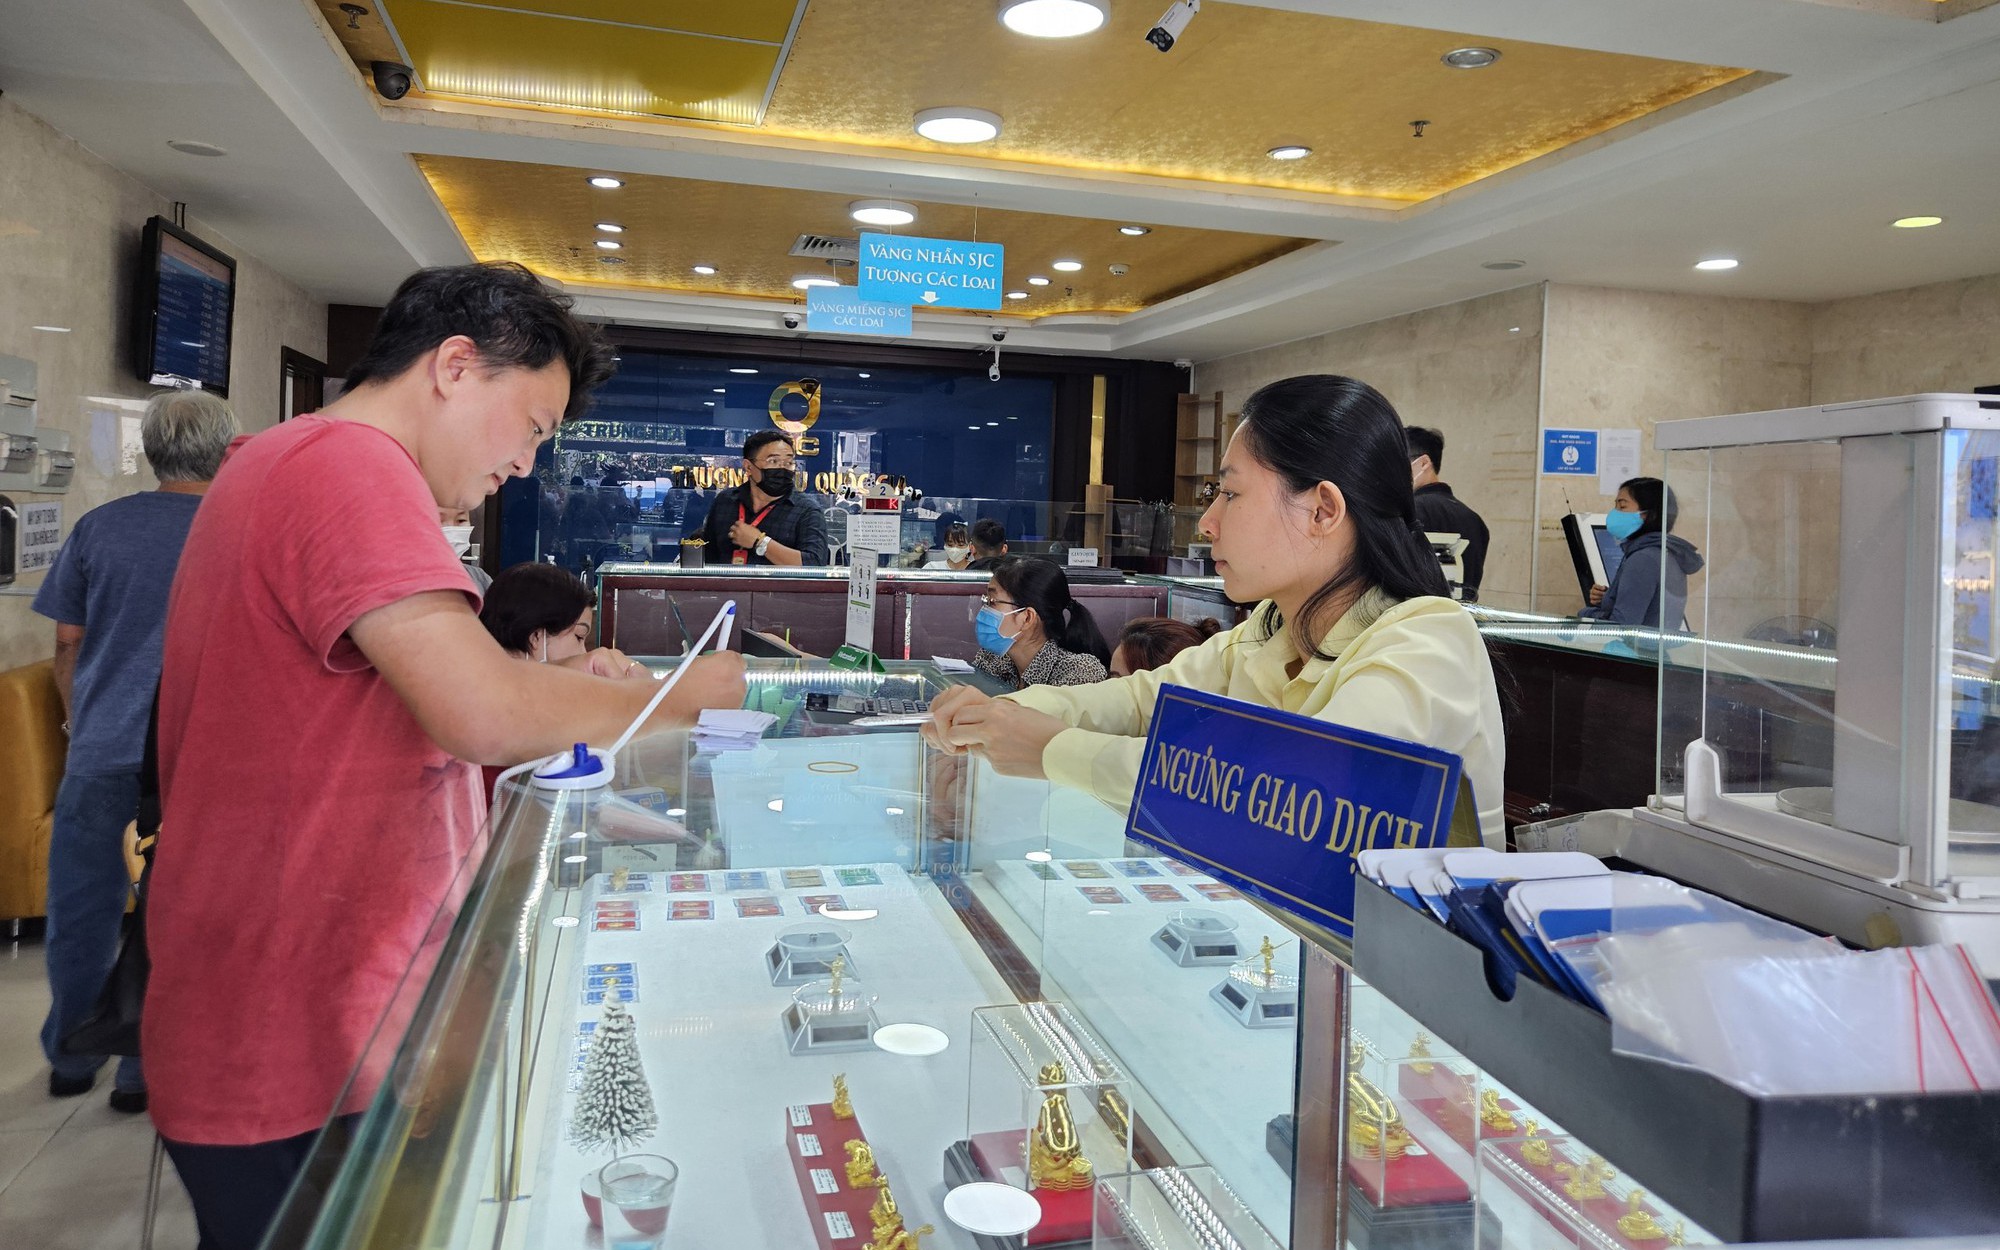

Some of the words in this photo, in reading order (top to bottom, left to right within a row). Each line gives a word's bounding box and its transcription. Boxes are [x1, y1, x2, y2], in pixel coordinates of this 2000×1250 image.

[869, 243, 912, 261] VÀNG
[917, 247, 964, 265] NHẪN
[968, 252, 995, 270] SJC
[865, 266, 923, 285] TƯỢNG
[926, 271, 958, 287] CÁC
[962, 274, 996, 291] LOẠI
[811, 301, 845, 314] VÀNG
[888, 307, 906, 318] SJC
[833, 314, 857, 327] CÁC
[879, 485, 887, 496] 2
[1247, 772, 1323, 843] GIAO
